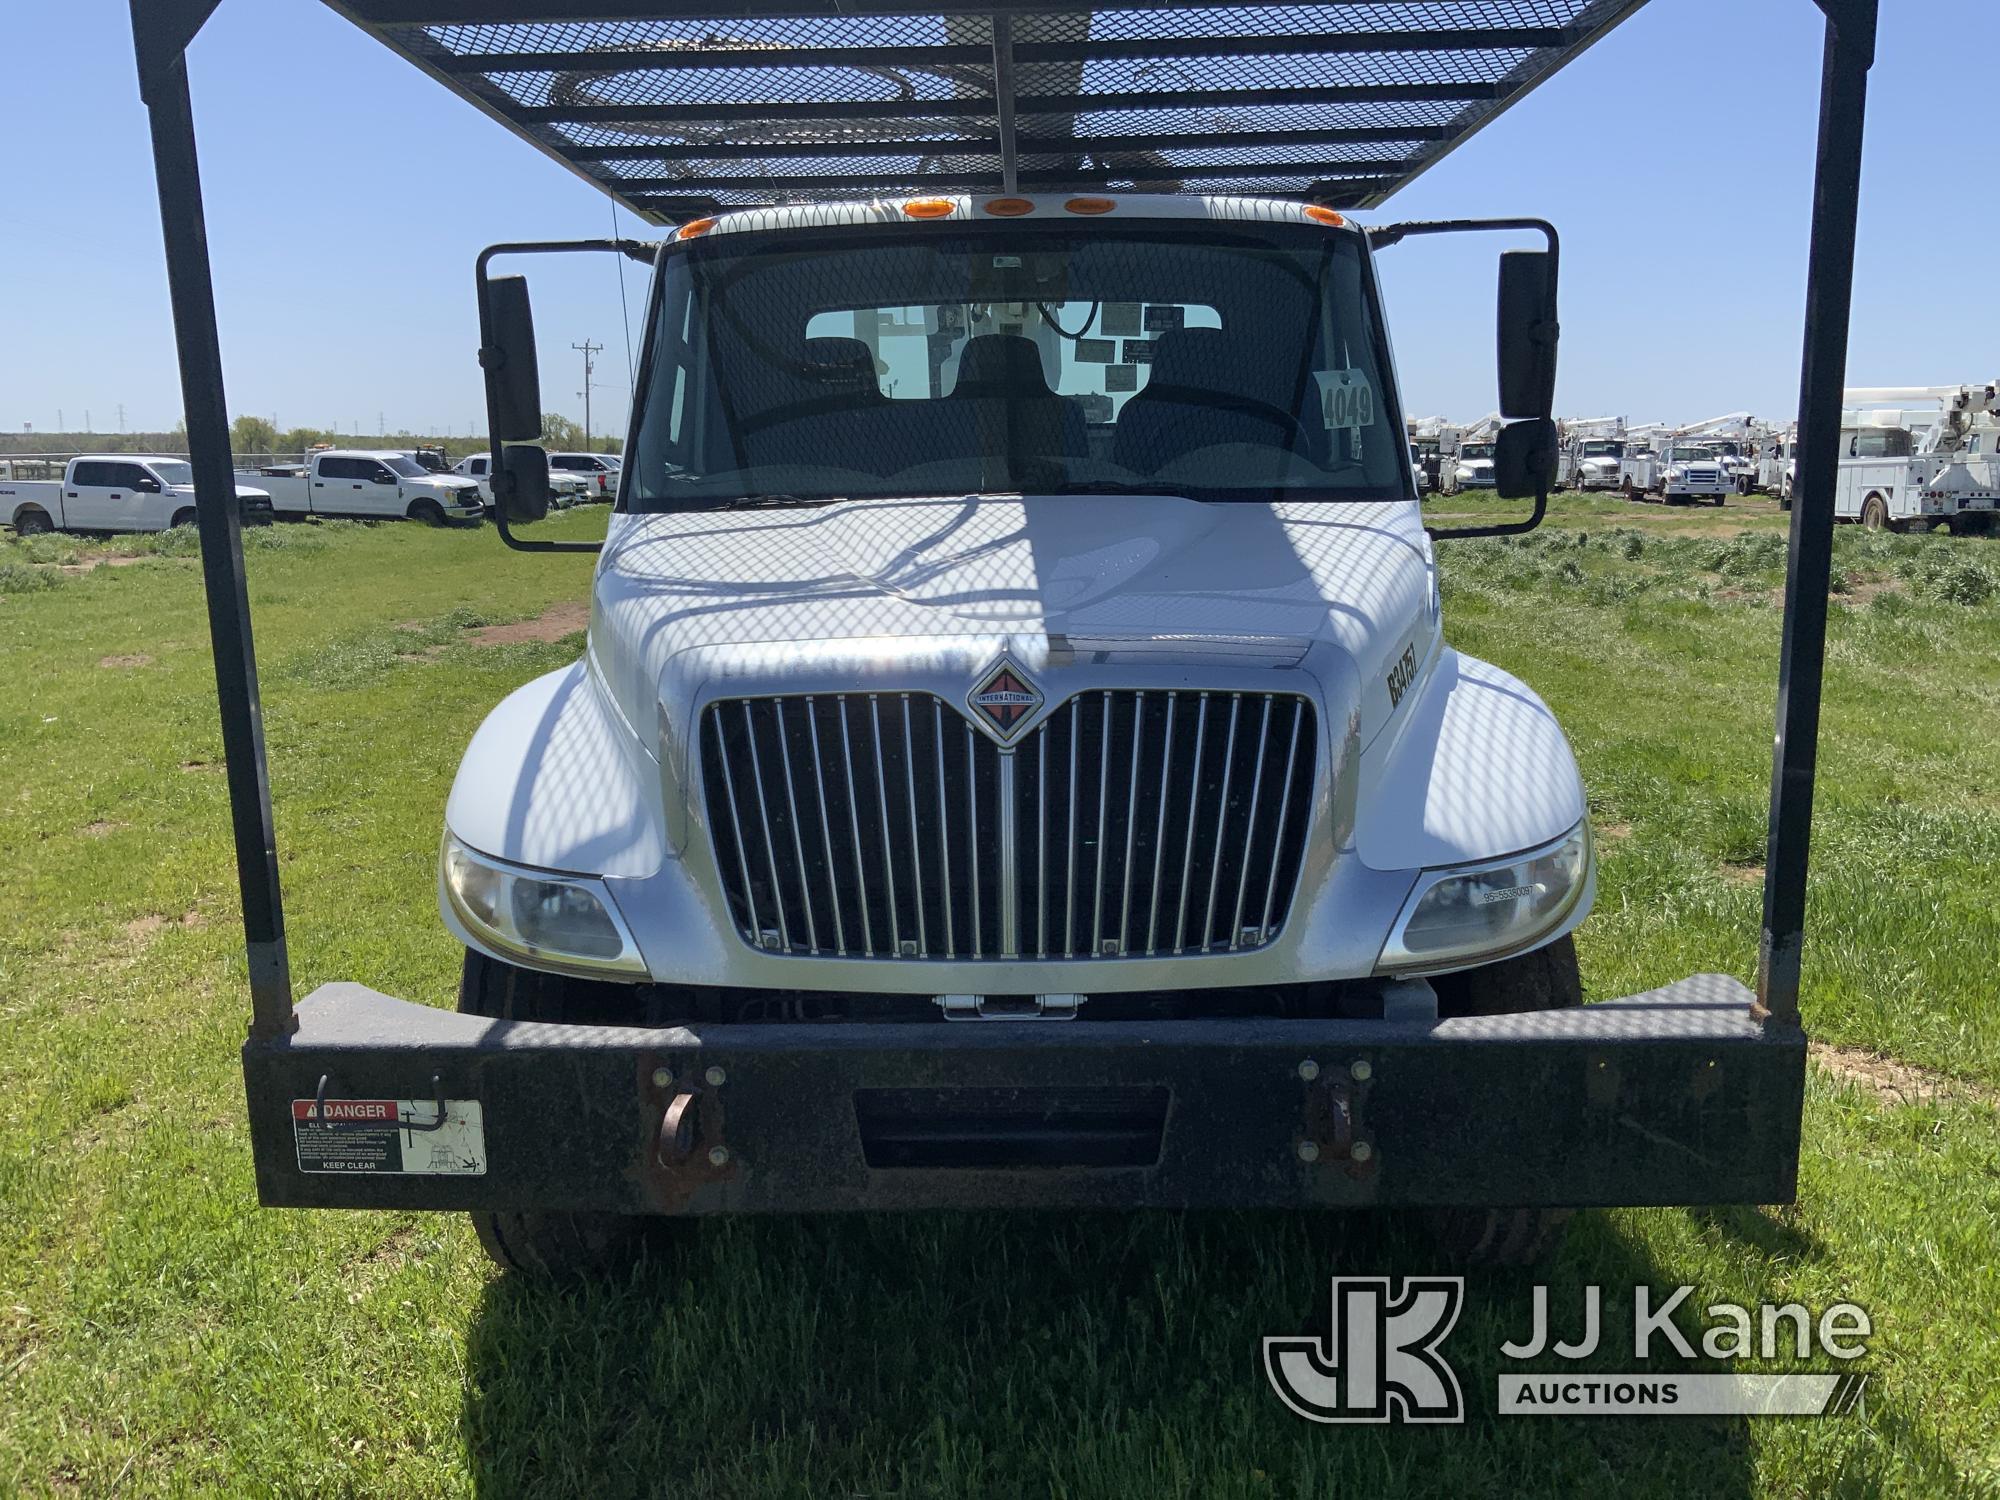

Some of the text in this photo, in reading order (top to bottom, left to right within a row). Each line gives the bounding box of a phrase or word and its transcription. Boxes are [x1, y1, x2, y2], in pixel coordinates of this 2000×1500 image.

[1323, 386, 1372, 427] 4049
[1386, 640, 1417, 710] B34757
[979, 692, 1034, 702] INTERNATIONAL
[323, 1104, 386, 1118] DANGER
[322, 1161, 376, 1170] KEEP CLEAR
